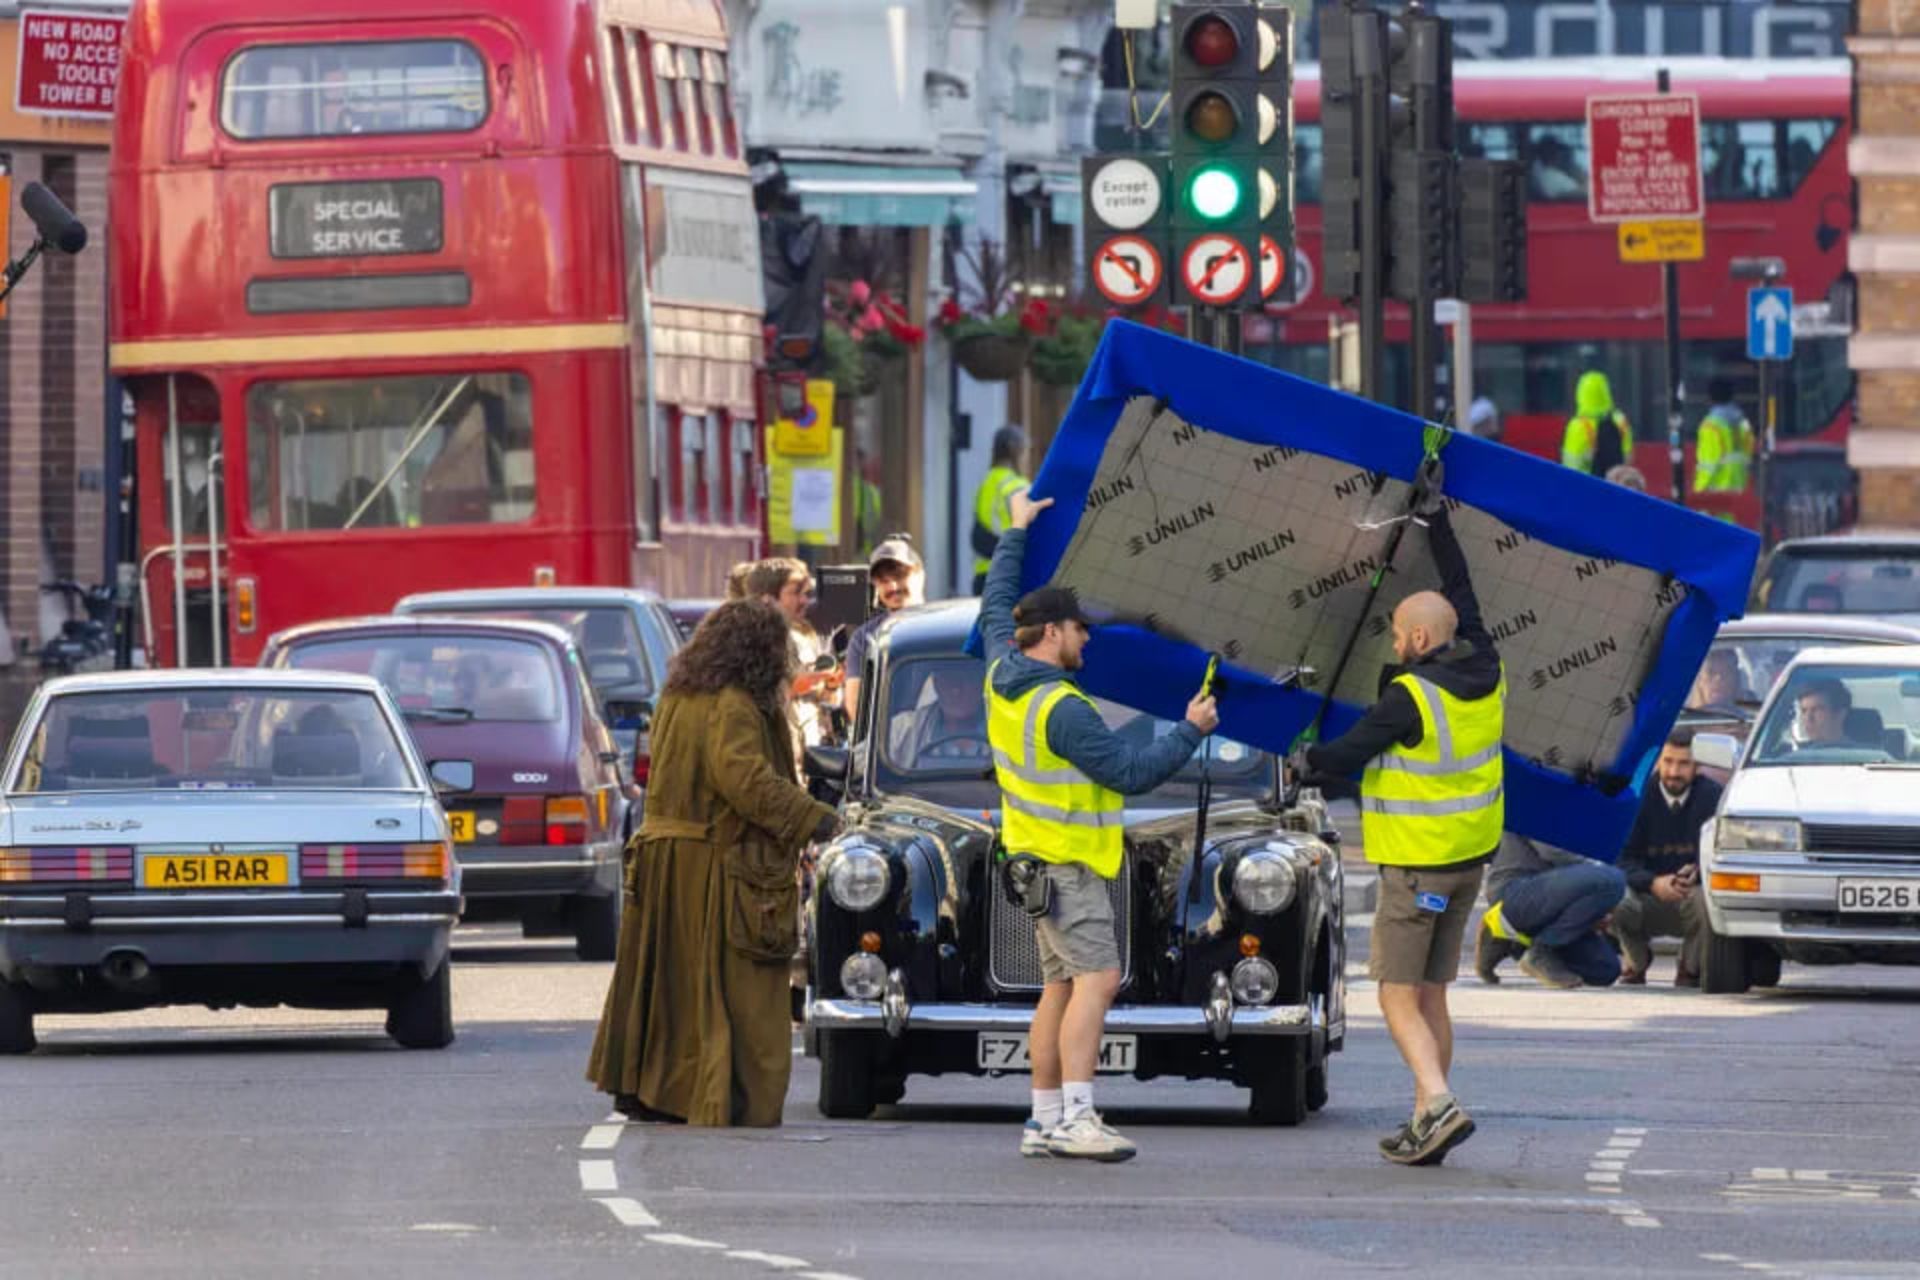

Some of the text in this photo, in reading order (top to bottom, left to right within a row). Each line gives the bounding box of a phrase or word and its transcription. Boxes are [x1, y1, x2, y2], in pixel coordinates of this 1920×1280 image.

[28, 20, 67, 39] NEW
[71, 22, 117, 42] ROAD
[43, 41, 122, 65] NO ACCE
[39, 83, 97, 104] TOWER
[1102, 180, 1149, 196] Except
[313, 199, 401, 222] SPECIAL
[1105, 195, 1146, 208] cycles
[312, 228, 405, 252] SERVICE
[1084, 475, 1135, 512] NILIN
[1145, 501, 1216, 546] UNILIN
[1226, 528, 1296, 573] UNILIN
[1306, 555, 1377, 600] UNILIN
[1491, 609, 1537, 642] NILIN
[1547, 635, 1618, 680] UNILIN
[163, 858, 270, 883] A51 RAR
[1097, 1041, 1132, 1067] MT
